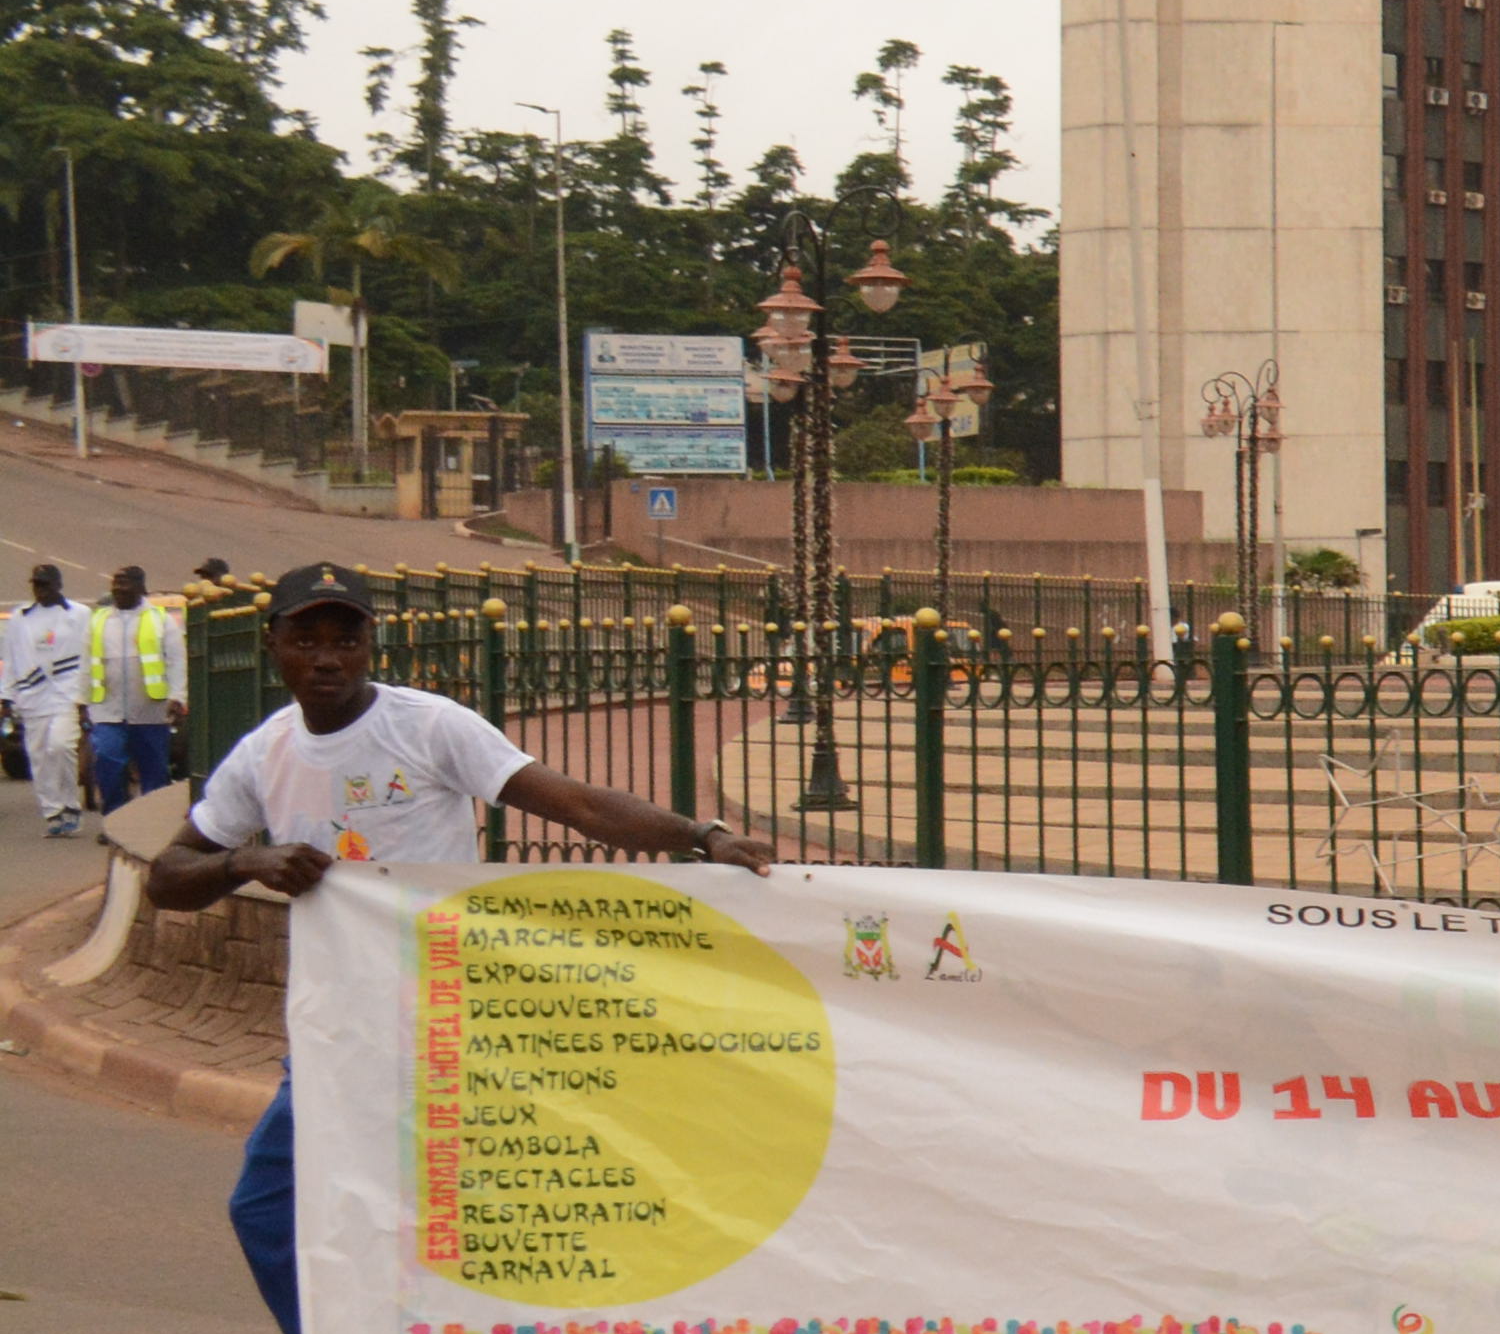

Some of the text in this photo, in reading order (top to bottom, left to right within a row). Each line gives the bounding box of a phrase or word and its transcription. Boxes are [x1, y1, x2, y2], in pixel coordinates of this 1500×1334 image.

[466, 895, 693, 921] SEMI-MARATHON
[1266, 903, 1397, 929] SOUS
[1413, 911, 1468, 933] LE
[462, 928, 714, 951] MARCHE SPORTIVE
[466, 961, 635, 984] EXPOSITIONS
[468, 997, 658, 1020] DECOUVERTES
[466, 1032, 603, 1057] MATINEES
[466, 1069, 617, 1093] INVENTIONS
[1139, 1070, 1242, 1122] DU
[1271, 1076, 1378, 1120] 14
[462, 1104, 537, 1128] JEUX
[463, 1135, 601, 1159] TOMBOLA
[459, 1166, 636, 1191] SPECTACLES
[463, 1198, 666, 1225] RESTAURATION
[463, 1230, 587, 1254] BUVETTE
[460, 1258, 616, 1286] CARNAVAL
